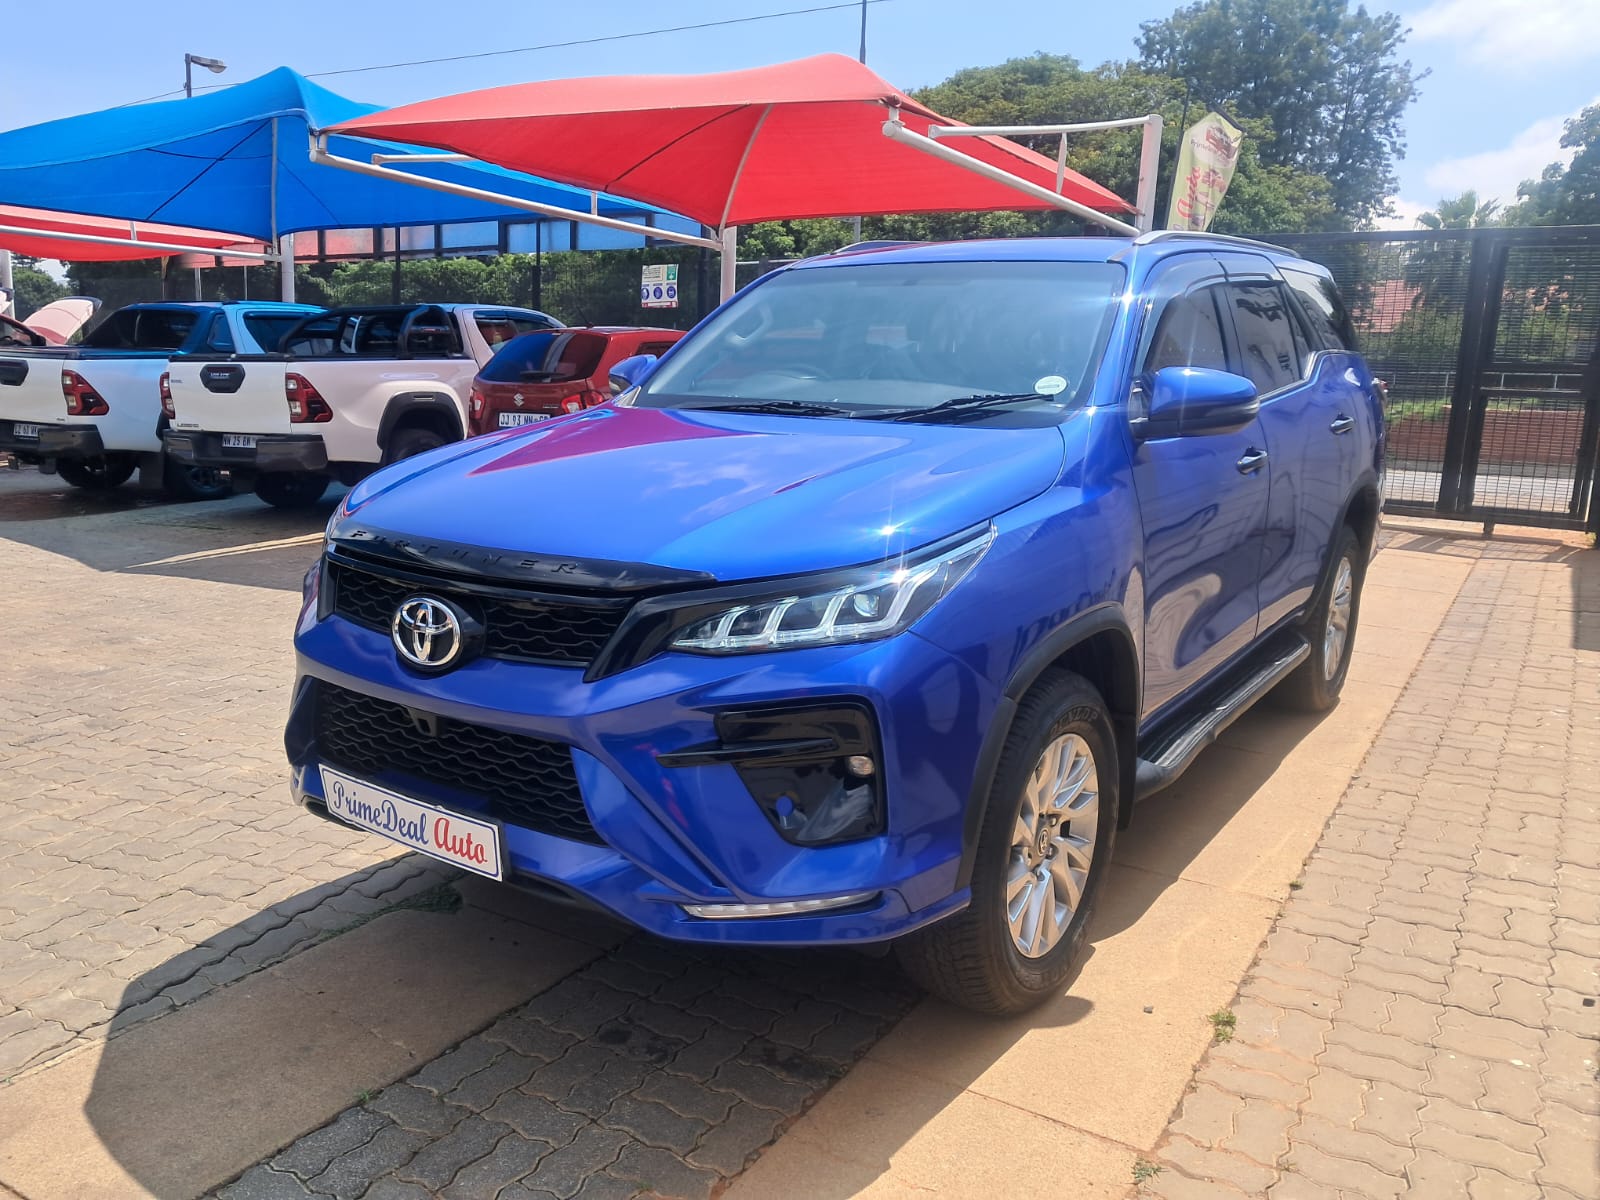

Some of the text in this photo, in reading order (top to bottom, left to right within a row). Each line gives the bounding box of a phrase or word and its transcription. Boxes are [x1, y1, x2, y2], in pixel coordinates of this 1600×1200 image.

[500, 414, 510, 425] JJ
[512, 415, 521, 425] 93
[333, 780, 489, 865] PrimeDeal Auto
